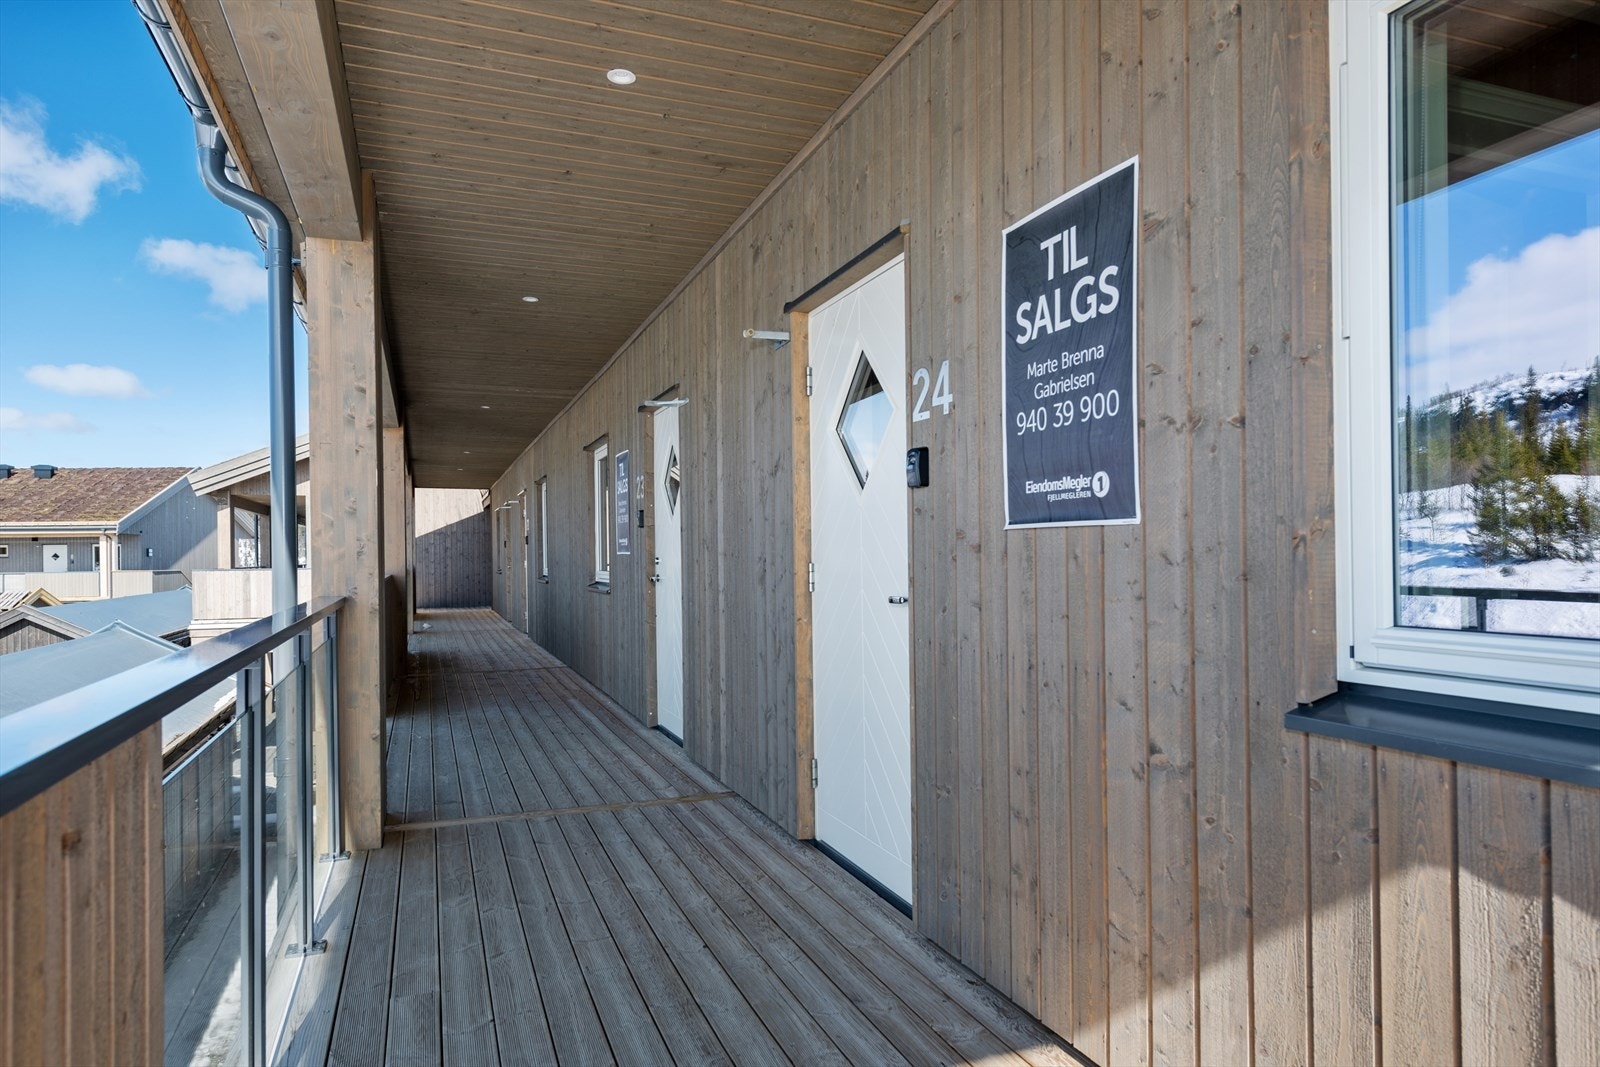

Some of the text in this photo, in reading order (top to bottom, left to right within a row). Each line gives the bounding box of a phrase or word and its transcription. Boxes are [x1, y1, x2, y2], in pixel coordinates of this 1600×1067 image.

[1040, 225, 1088, 281] TIL
[1016, 265, 1120, 345] SALGS
[1027, 344, 1104, 380] Marte Brenna
[912, 359, 953, 422] 24
[1034, 371, 1095, 400] Gabrielsen
[1016, 389, 1120, 435] 940 39 900
[636, 475, 644, 499] 23
[1025, 474, 1092, 494] EiendomsMegler
[1047, 490, 1092, 503] FJELLMEGLEREN
